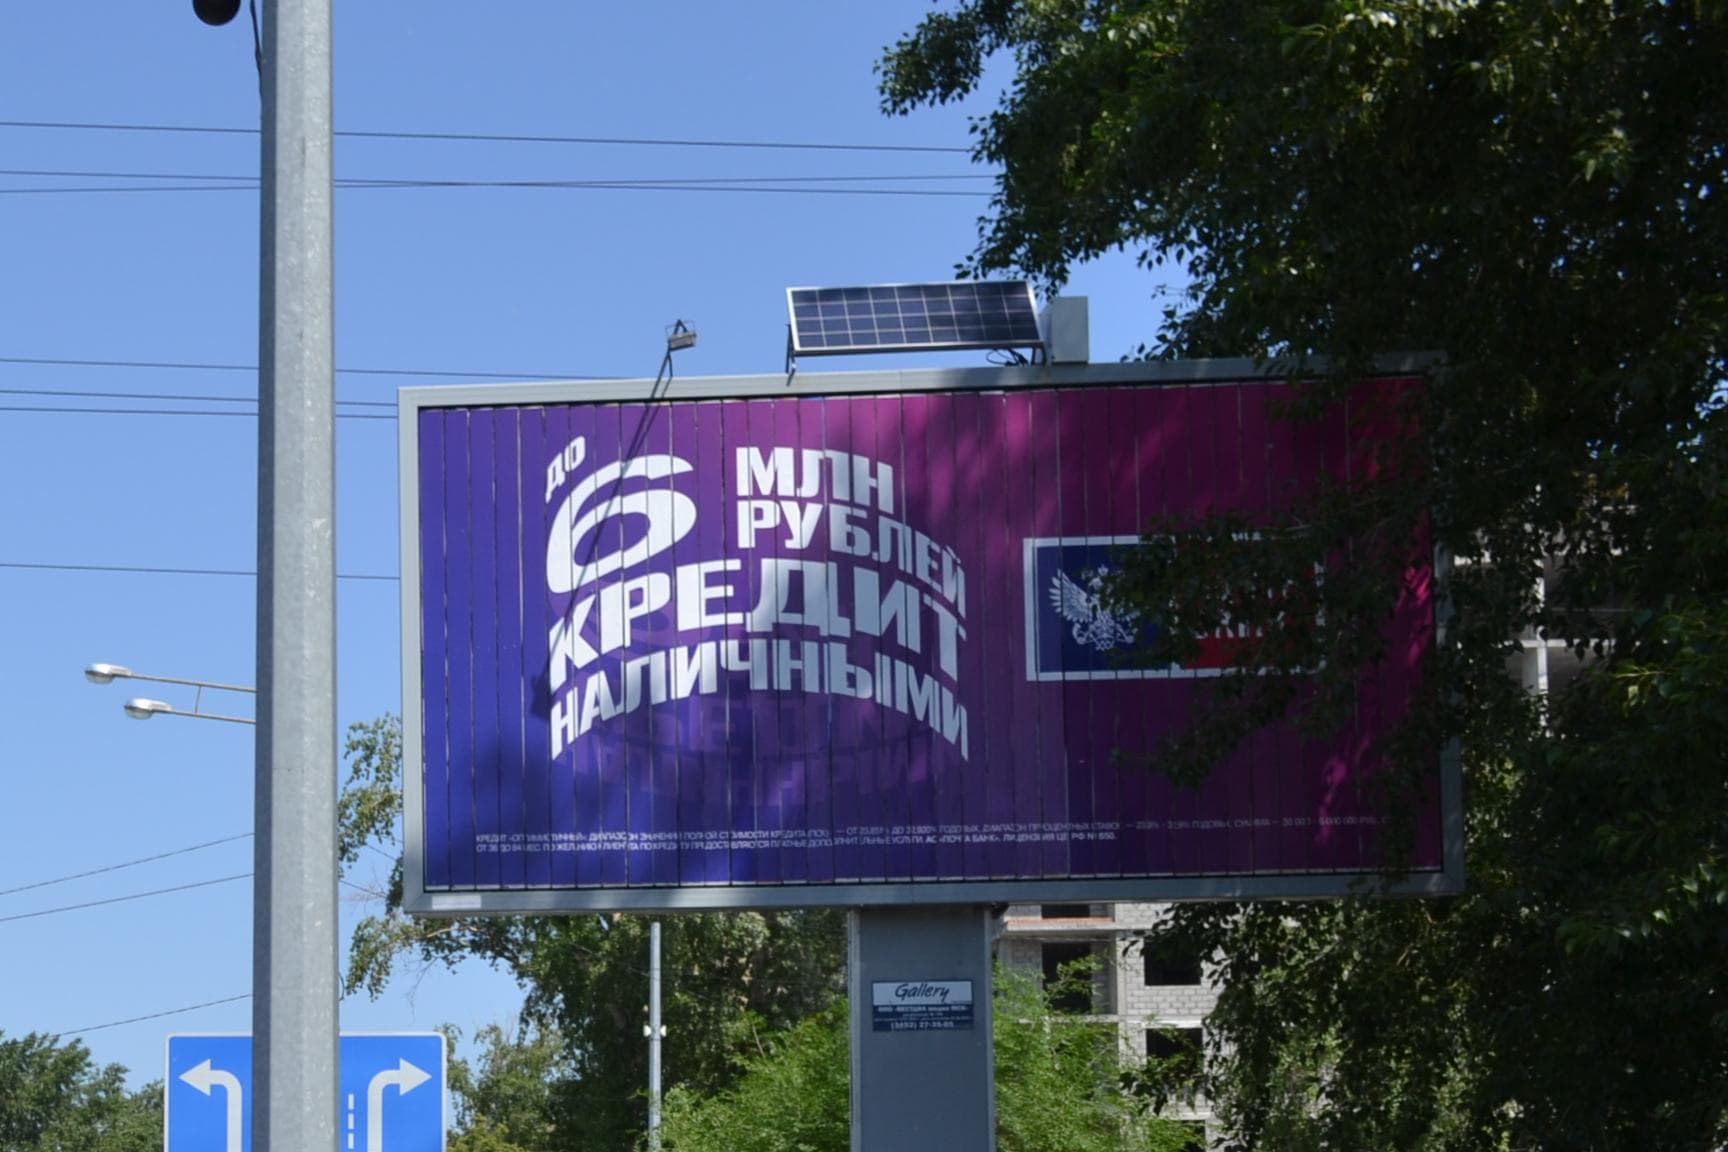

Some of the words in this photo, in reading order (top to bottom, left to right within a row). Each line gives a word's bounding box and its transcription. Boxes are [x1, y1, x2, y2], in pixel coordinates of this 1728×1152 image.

[545, 436, 586, 504] ДО
[736, 447, 893, 514] МЛН
[547, 454, 697, 595] 6
[737, 501, 965, 617] РУБЛЕЙ
[550, 558, 966, 698] КРЕДИТ
[551, 638, 969, 761] НАЛИЧНЫМИ
[1091, 821, 1120, 831] СТАВО
[894, 983, 951, 1002] Gallery
